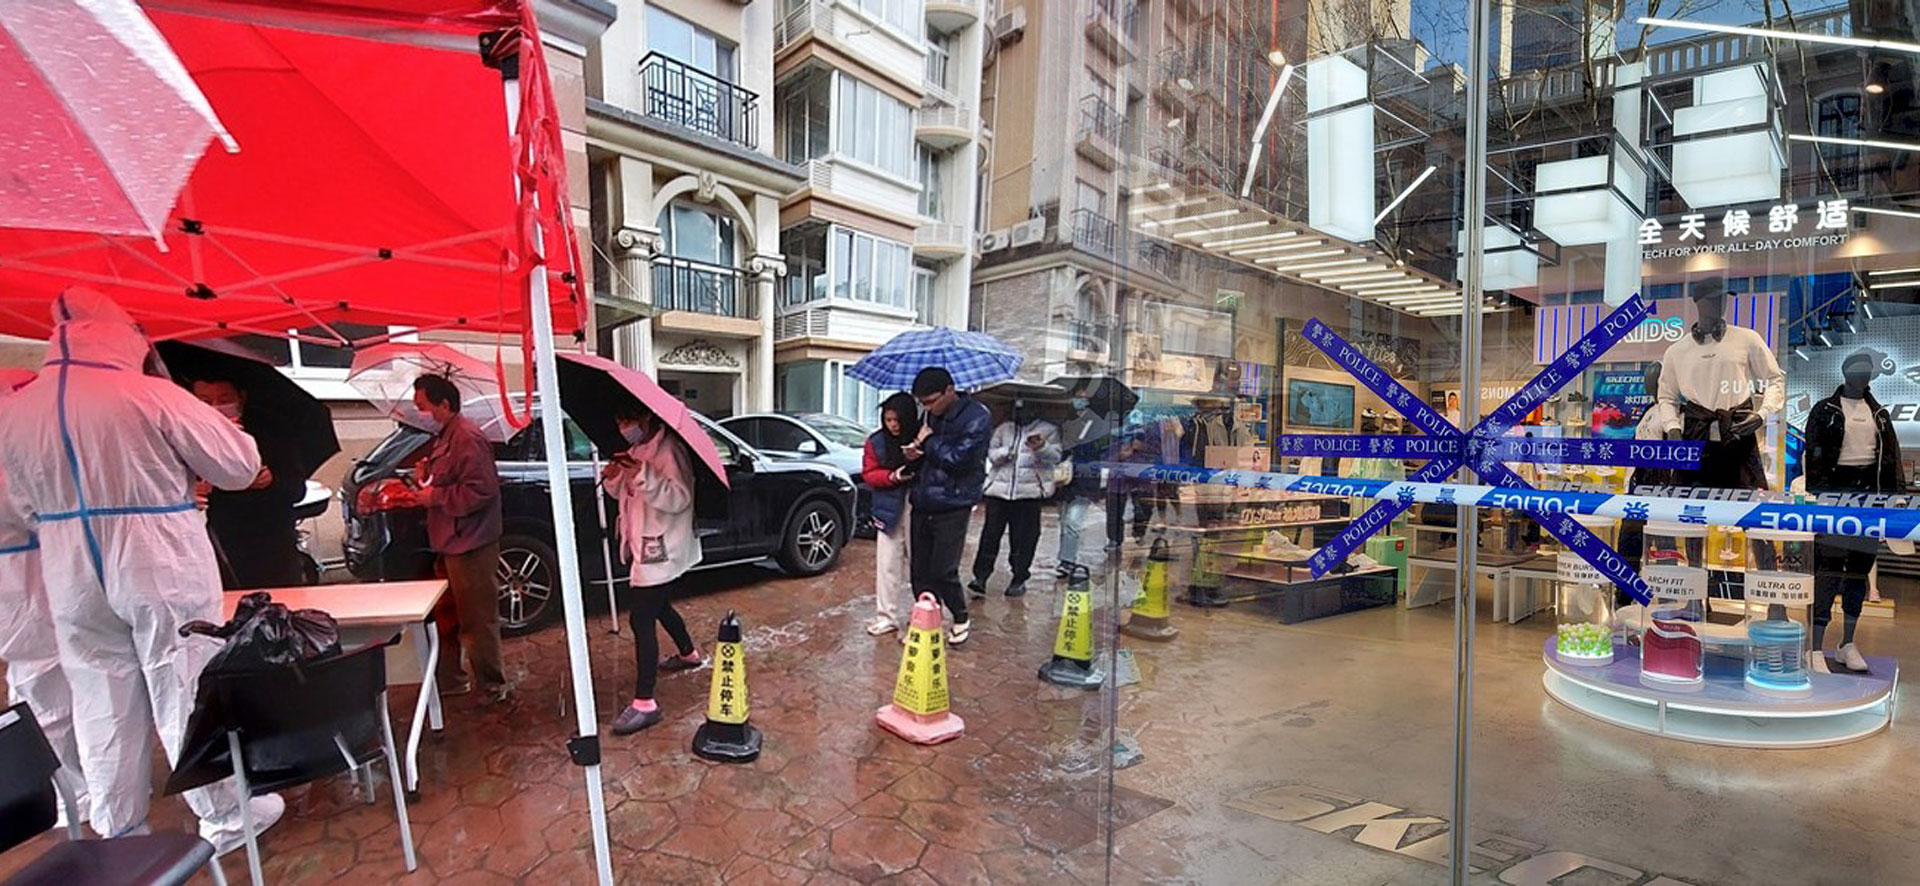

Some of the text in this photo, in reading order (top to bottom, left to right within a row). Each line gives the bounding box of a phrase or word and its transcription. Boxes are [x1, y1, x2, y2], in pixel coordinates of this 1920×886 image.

[1638, 199, 1849, 244] 全天候舒适
[1669, 247, 1691, 258] FOR
[1691, 243, 1726, 256] YOUR
[1727, 239, 1782, 254] ALL-DAY
[1783, 234, 1849, 249] COMFORT
[1507, 368, 1562, 417] POLICE
[1564, 338, 1596, 370] 警察
[1281, 436, 1305, 452] 警察
[1314, 439, 1361, 452] POLICE
[1368, 437, 1395, 453] 警察
[1406, 439, 1459, 453] POLICE
[1509, 442, 1569, 457] POLICE
[1581, 442, 1615, 460] 警察
[1629, 445, 1701, 462] POLICE
[1311, 322, 1335, 348] 警察
[1338, 346, 1383, 387] POLICE
[1386, 382, 1411, 408] 警察
[1558, 518, 1590, 548] 警察
[1597, 549, 1654, 600] POLICE
[1300, 481, 1367, 498] POLICE
[1492, 493, 1580, 515] POLICE
[1314, 544, 1338, 570] 警察
[1342, 505, 1388, 547] POLICE
[1760, 511, 1887, 539] POLICE
[1648, 575, 1685, 586] ARCH FIT
[1757, 581, 1802, 591] ULTRA GO
[1063, 606, 1080, 651] 禁止停车
[719, 659, 734, 717] 禁止停车
